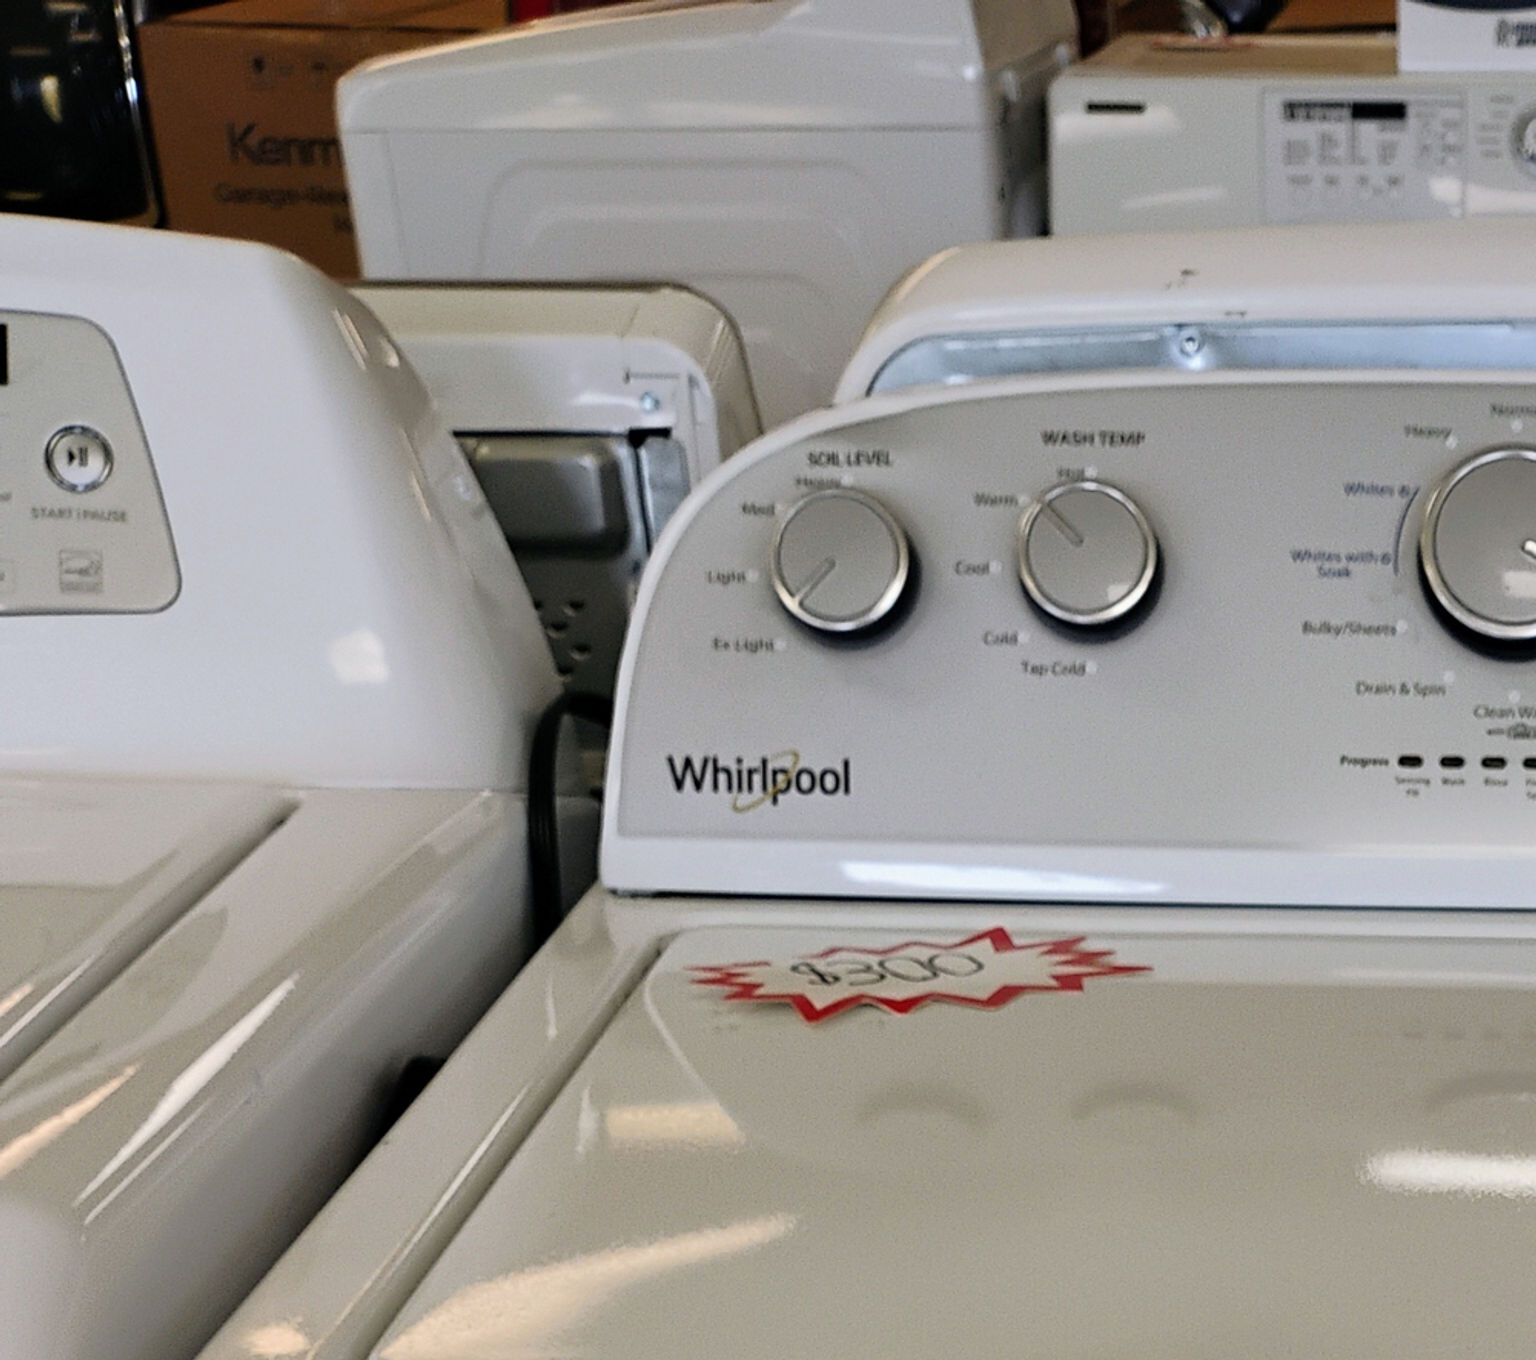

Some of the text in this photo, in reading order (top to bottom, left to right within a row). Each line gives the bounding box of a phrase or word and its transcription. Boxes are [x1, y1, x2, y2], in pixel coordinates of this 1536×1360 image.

[1041, 430, 1145, 446] WASH TEMP
[808, 450, 891, 467] SOIL LEVEL
[1344, 482, 1394, 497] Whites
[975, 493, 1018, 507] Warm
[1292, 550, 1341, 564] Whites
[1355, 681, 1396, 697] Drain
[1413, 681, 1448, 699] Spin
[1473, 705, 1516, 720] Clean
[1340, 754, 1389, 768] Progress
[666, 753, 852, 807] Whirlpool
[791, 952, 984, 986] $300
